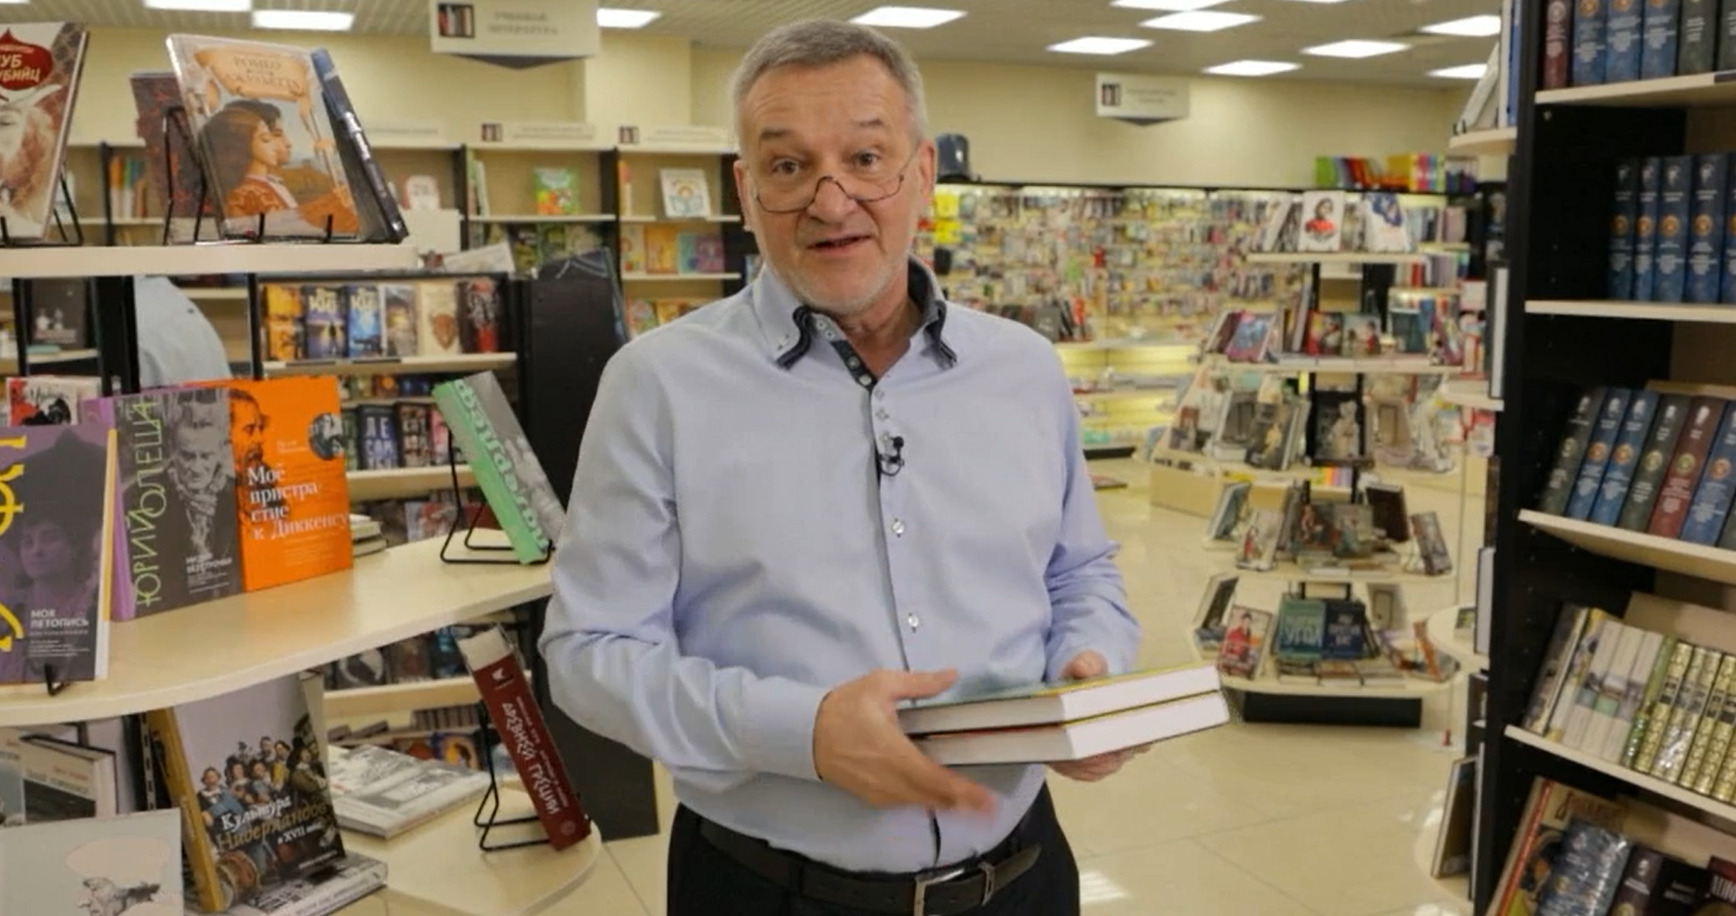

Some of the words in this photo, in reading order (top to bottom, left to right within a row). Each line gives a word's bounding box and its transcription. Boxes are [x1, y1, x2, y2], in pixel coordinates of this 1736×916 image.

[131, 401, 168, 518] ОЛЕША
[251, 505, 290, 522] стие
[271, 512, 349, 540] Диккенсу
[30, 609, 56, 618] МОЯ
[30, 618, 90, 629] ЛЕТОПИСЬ
[502, 703, 535, 761] ДРЕВНЕЙ
[528, 763, 561, 815] ГРЕЦИИ
[221, 795, 292, 833] Культура
